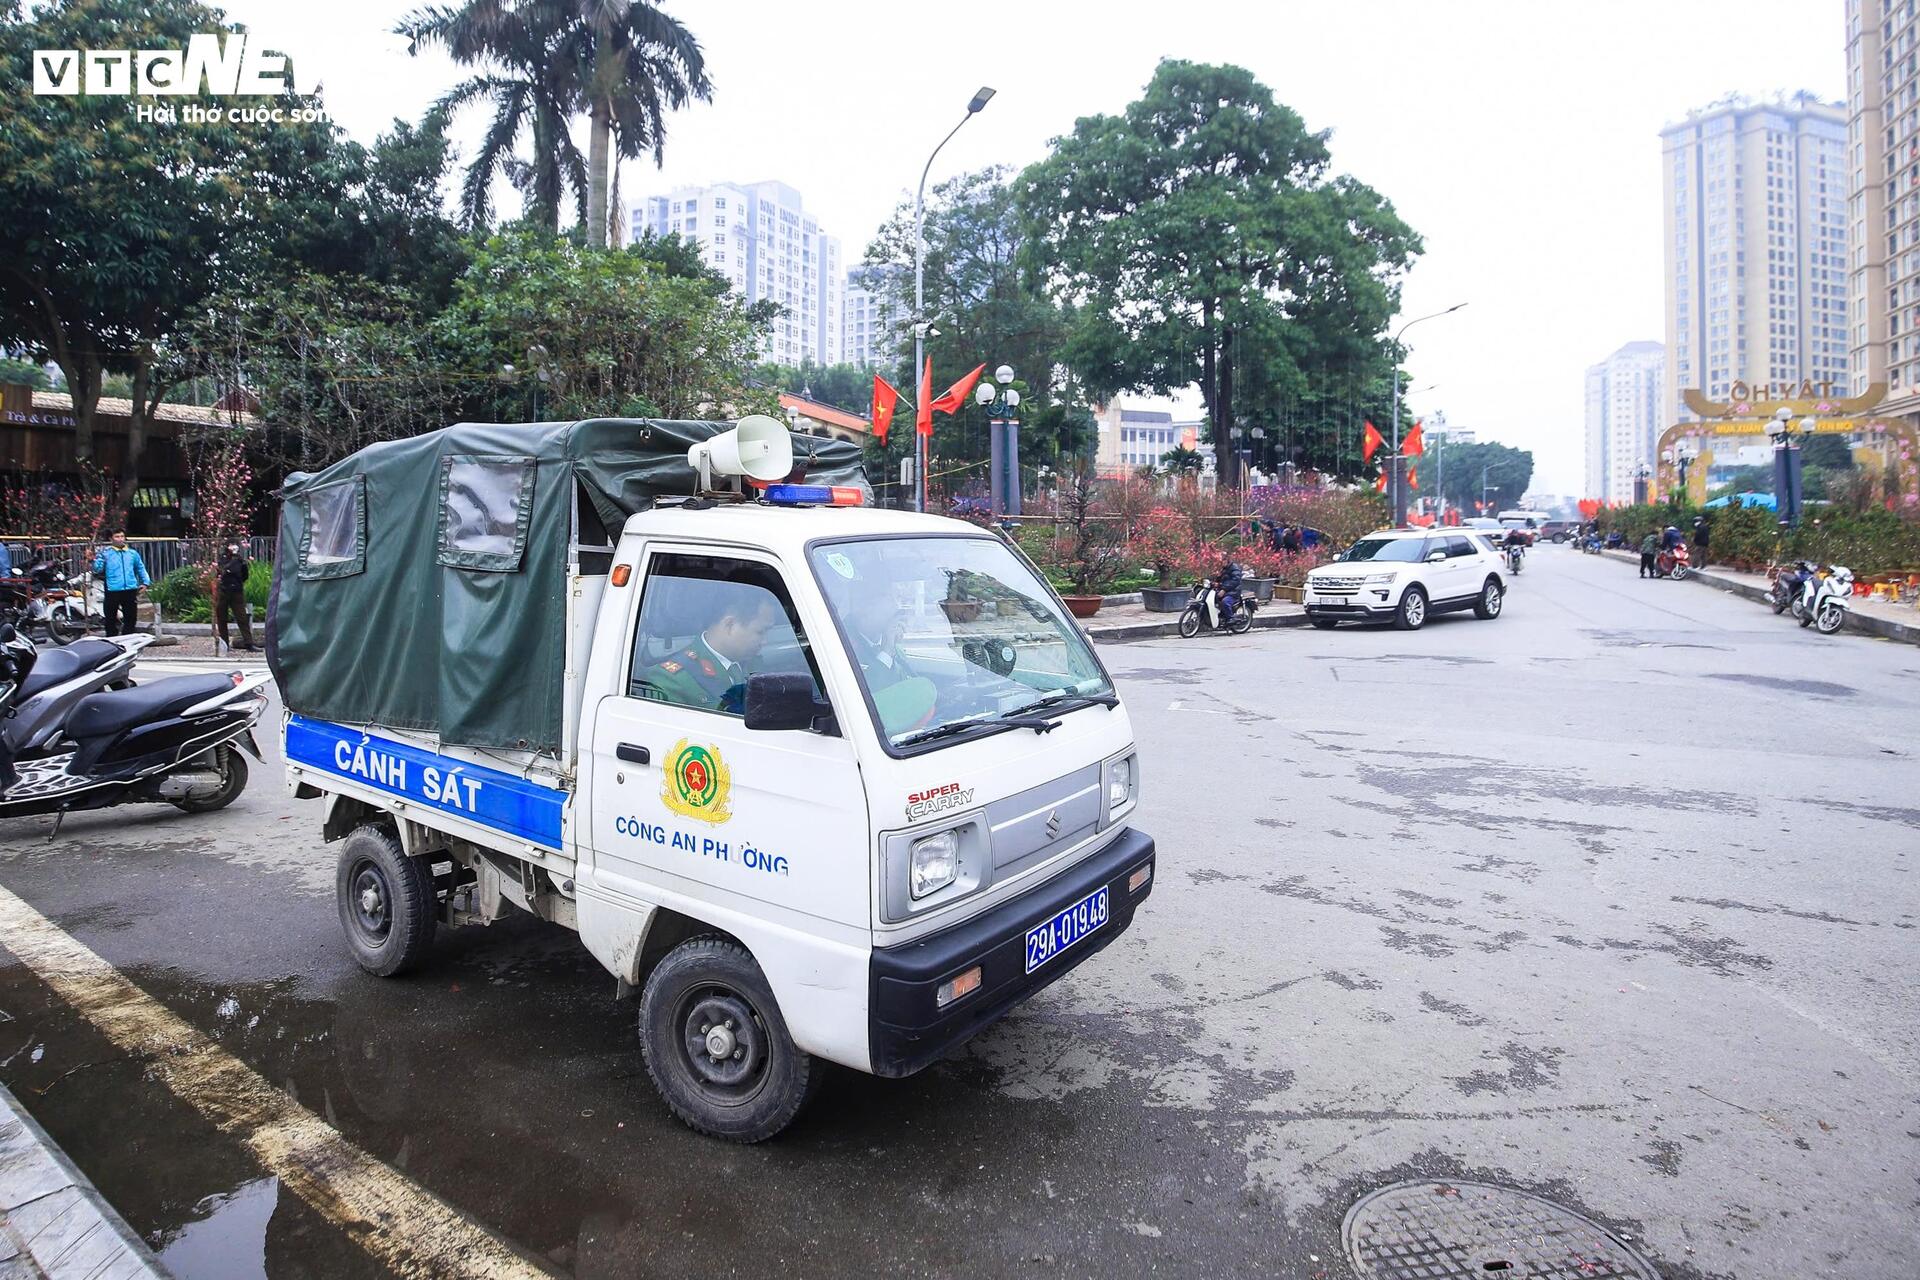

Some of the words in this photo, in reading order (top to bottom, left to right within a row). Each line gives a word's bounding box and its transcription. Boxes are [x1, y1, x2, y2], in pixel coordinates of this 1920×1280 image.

[335, 736, 406, 790] CẢNH
[423, 766, 482, 812] SÁT
[907, 788, 975, 820] CARRY
[908, 783, 960, 804] SUPER
[616, 815, 665, 844] CÔNG
[672, 831, 696, 853] AN
[1029, 892, 1106, 968] 29A-019.48
